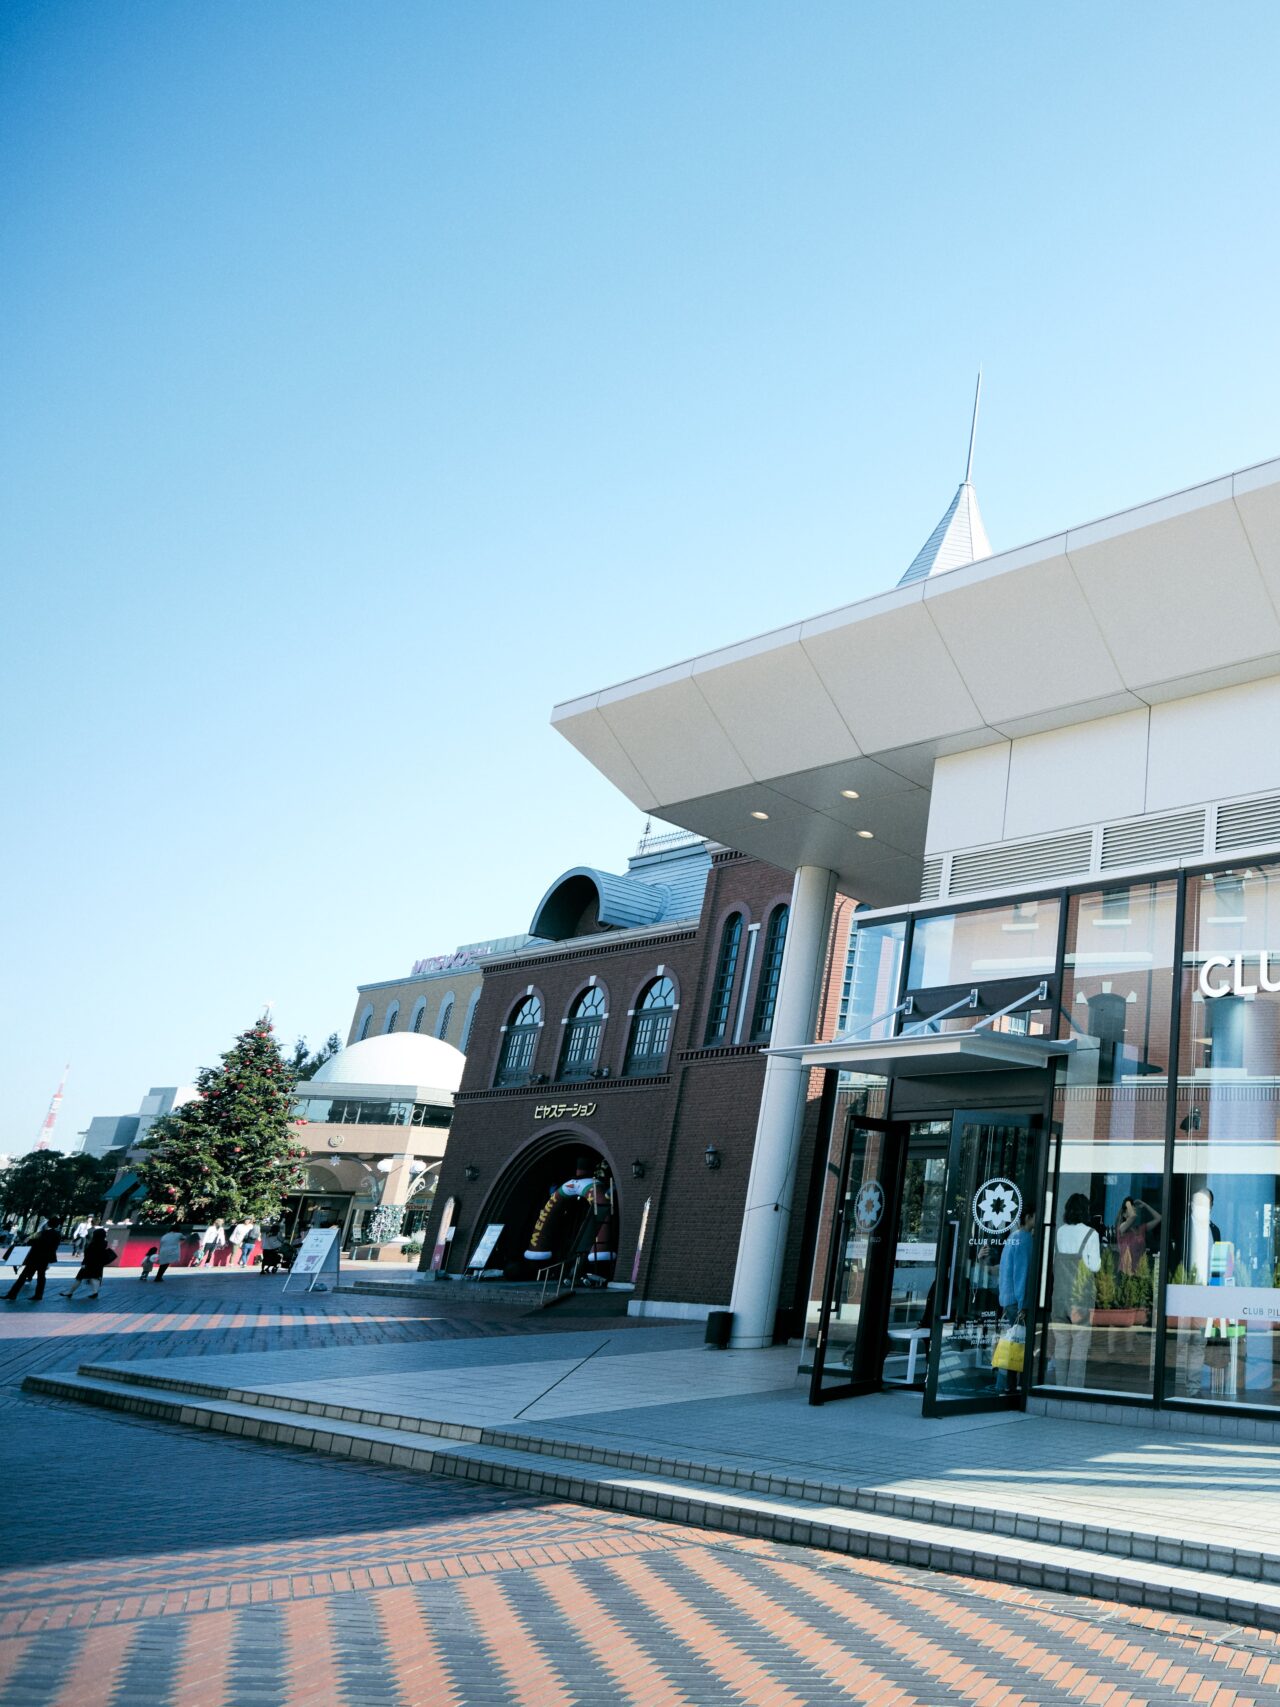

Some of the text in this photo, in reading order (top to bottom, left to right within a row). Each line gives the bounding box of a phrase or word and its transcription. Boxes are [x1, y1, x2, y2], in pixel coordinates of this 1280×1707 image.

[534, 1103, 597, 1119] ビヤステーション
[968, 1238, 1020, 1246] CLUB PILATES
[1242, 1307, 1264, 1316] CLUB
